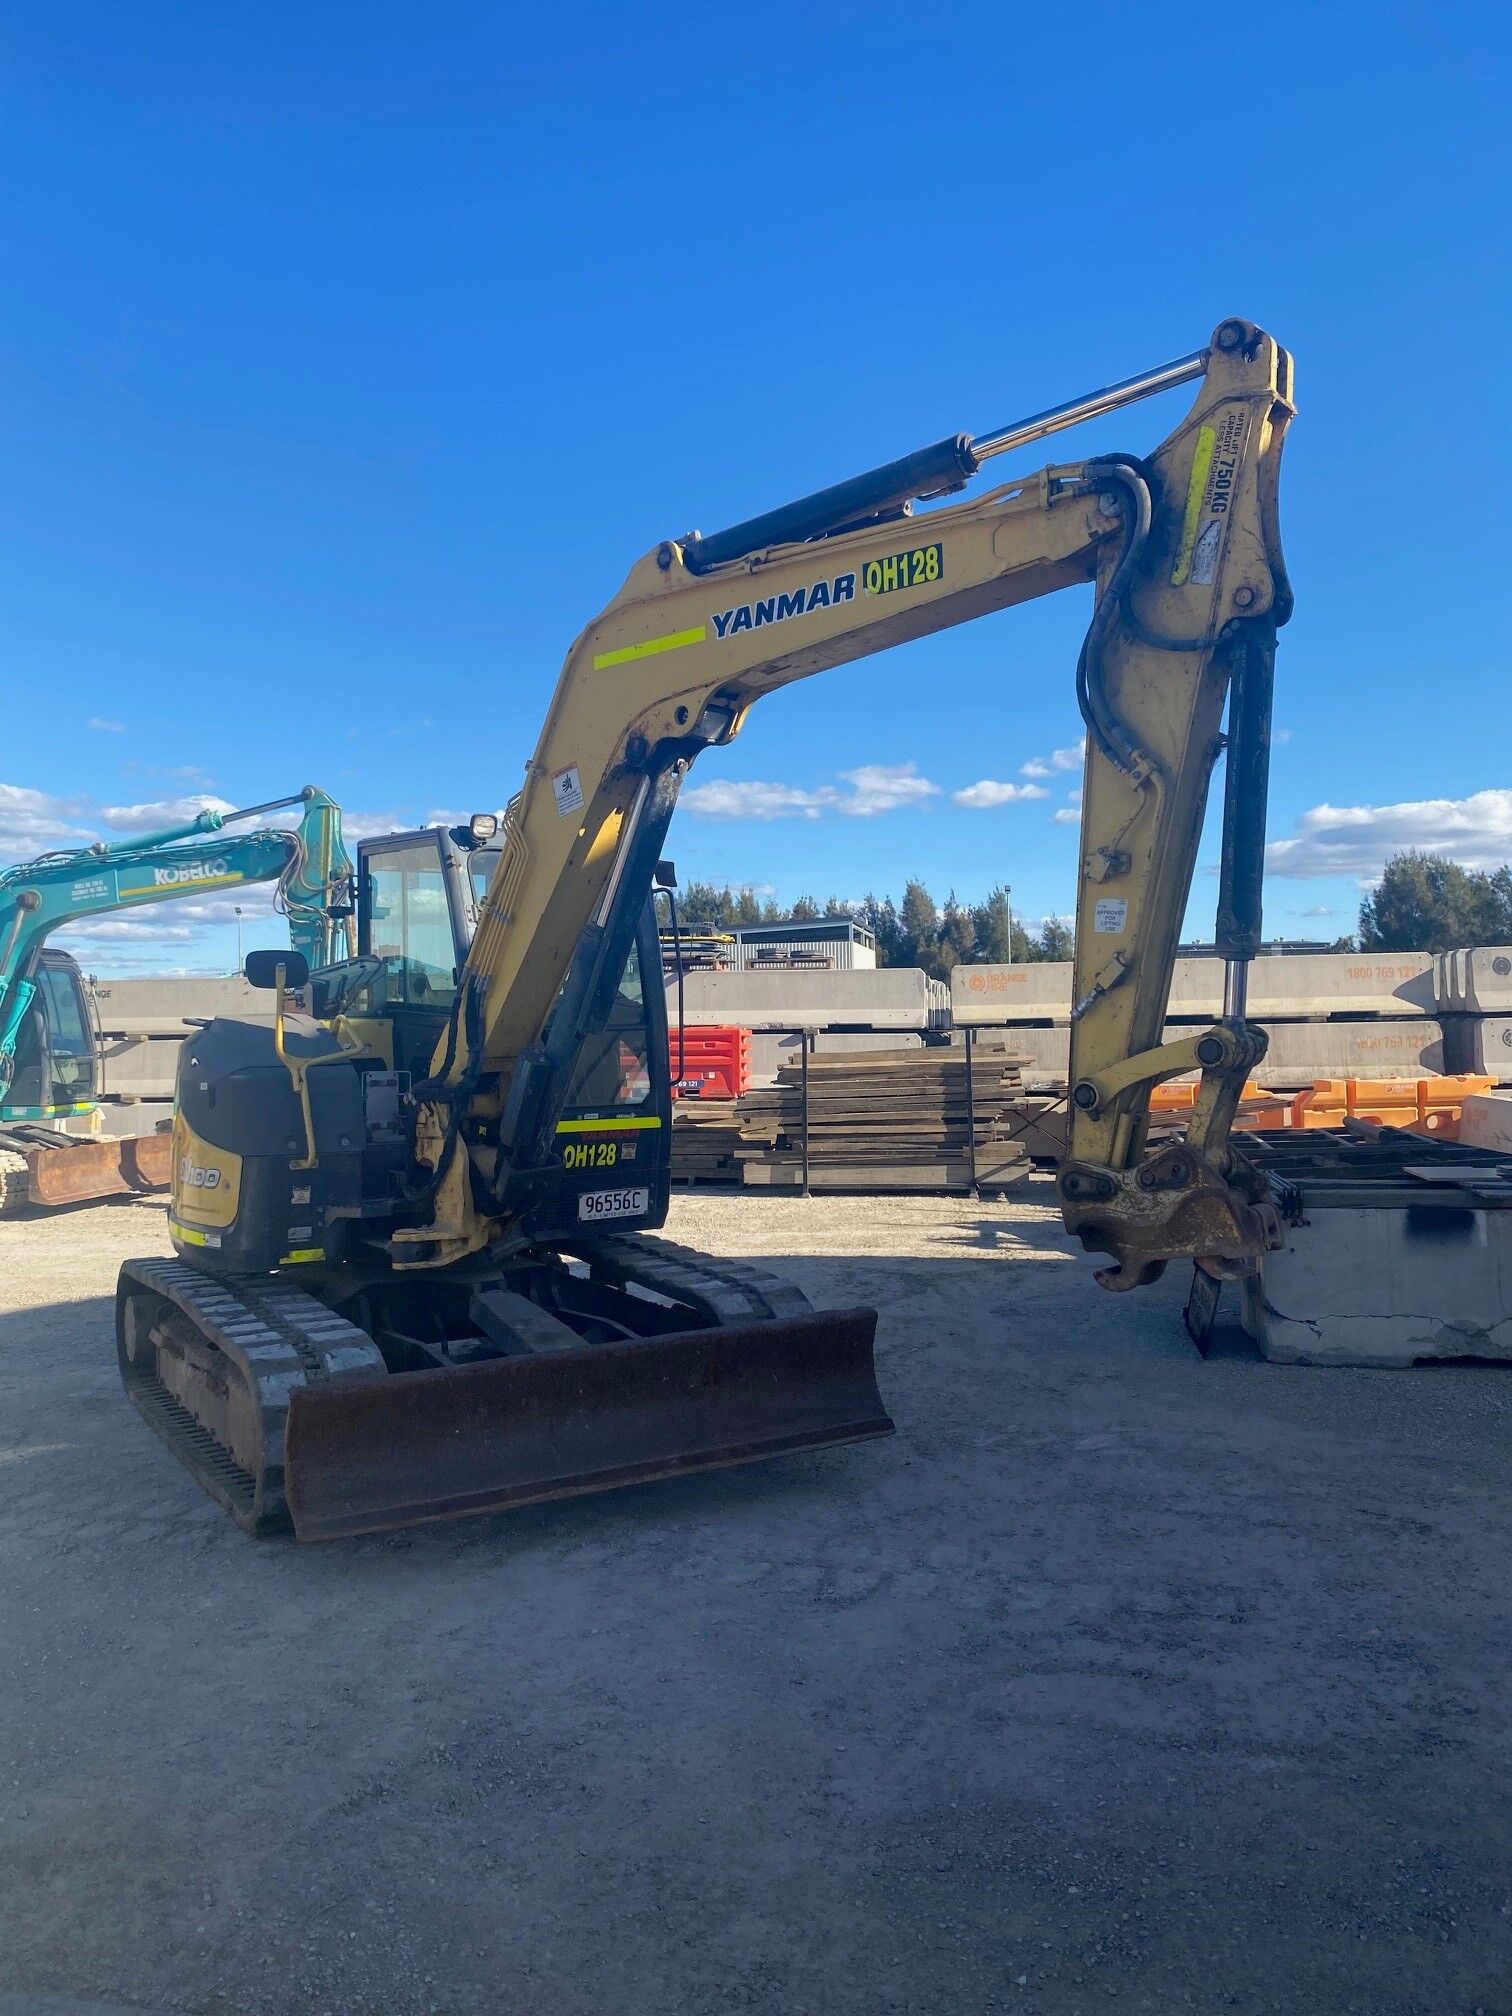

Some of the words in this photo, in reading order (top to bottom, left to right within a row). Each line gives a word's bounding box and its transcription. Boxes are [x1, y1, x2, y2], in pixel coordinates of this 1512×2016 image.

[1223, 415, 1236, 454] CAPACITY
[1234, 412, 1245, 437] RATED
[1230, 440, 1239, 456] LIFT
[1205, 445, 1221, 506] ATTACHMENTS
[711, 573, 856, 638] YANMAR
[585, 1191, 641, 1214] 96556C
